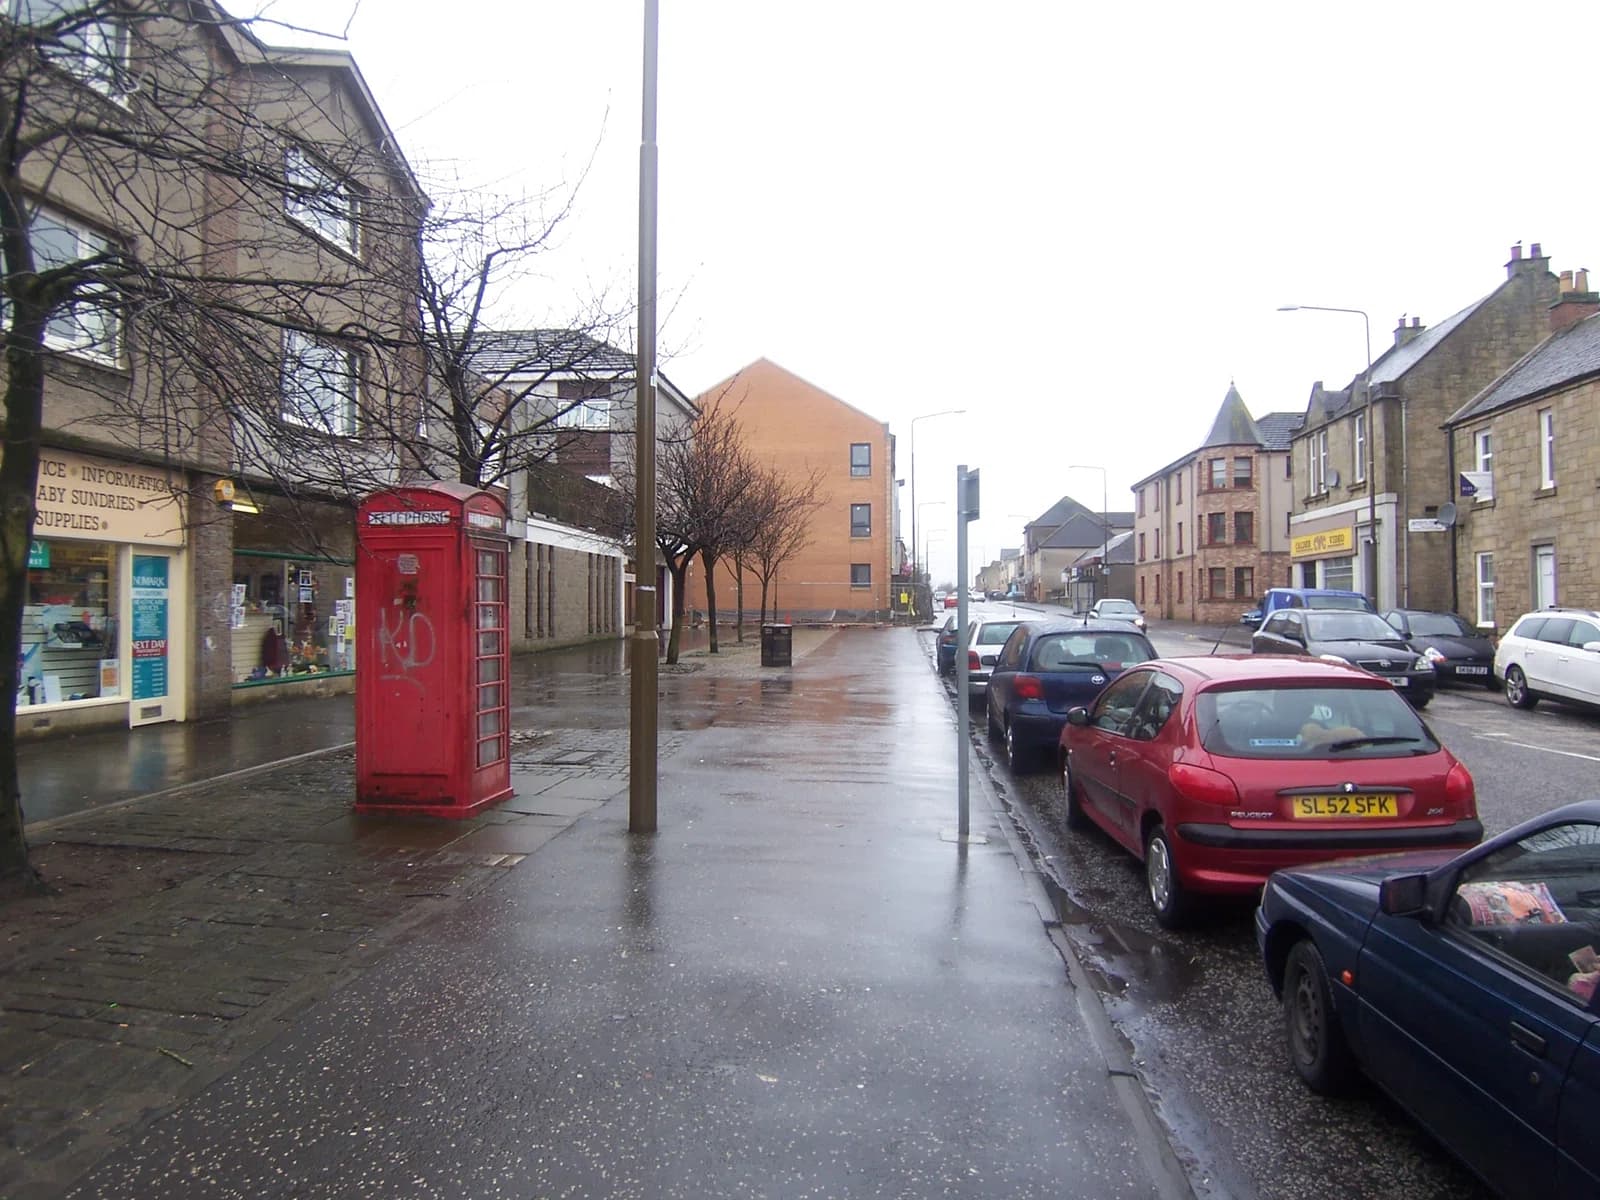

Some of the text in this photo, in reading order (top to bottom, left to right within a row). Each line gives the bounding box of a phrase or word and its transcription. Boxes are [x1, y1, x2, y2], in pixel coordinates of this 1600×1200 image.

[39, 459, 173, 493] ICE INFORMATION
[37, 484, 136, 511] ABY SUNDRIES
[35, 510, 99, 531] SUPPLIES
[30, 540, 46, 554] CY
[131, 639, 166, 650] NEXT DAY
[1302, 796, 1390, 814] SL52 SFK
[1231, 811, 1274, 819] PEUGEOT
